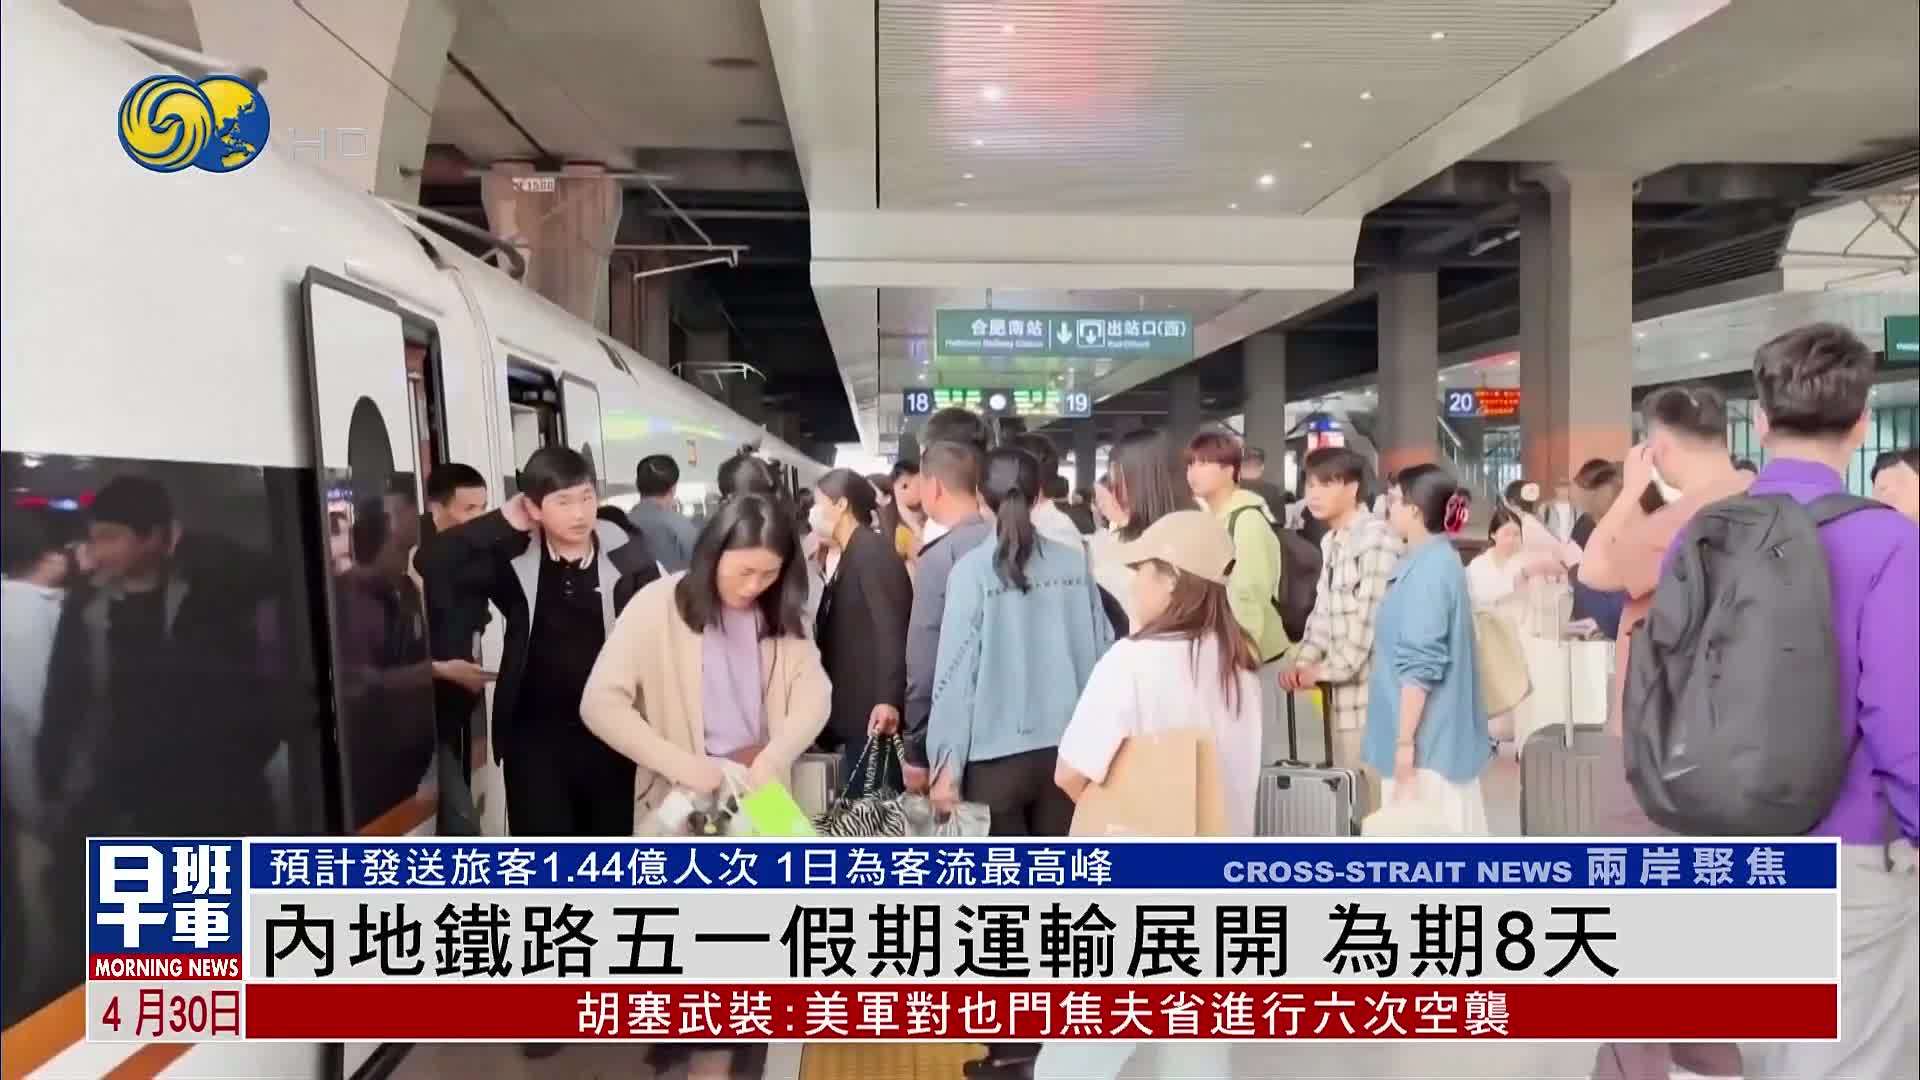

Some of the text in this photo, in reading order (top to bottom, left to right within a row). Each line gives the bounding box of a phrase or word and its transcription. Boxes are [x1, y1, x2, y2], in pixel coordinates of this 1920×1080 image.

[906, 392, 929, 412] 18
[1066, 393, 1087, 412] 19
[1449, 391, 1473, 412] 20
